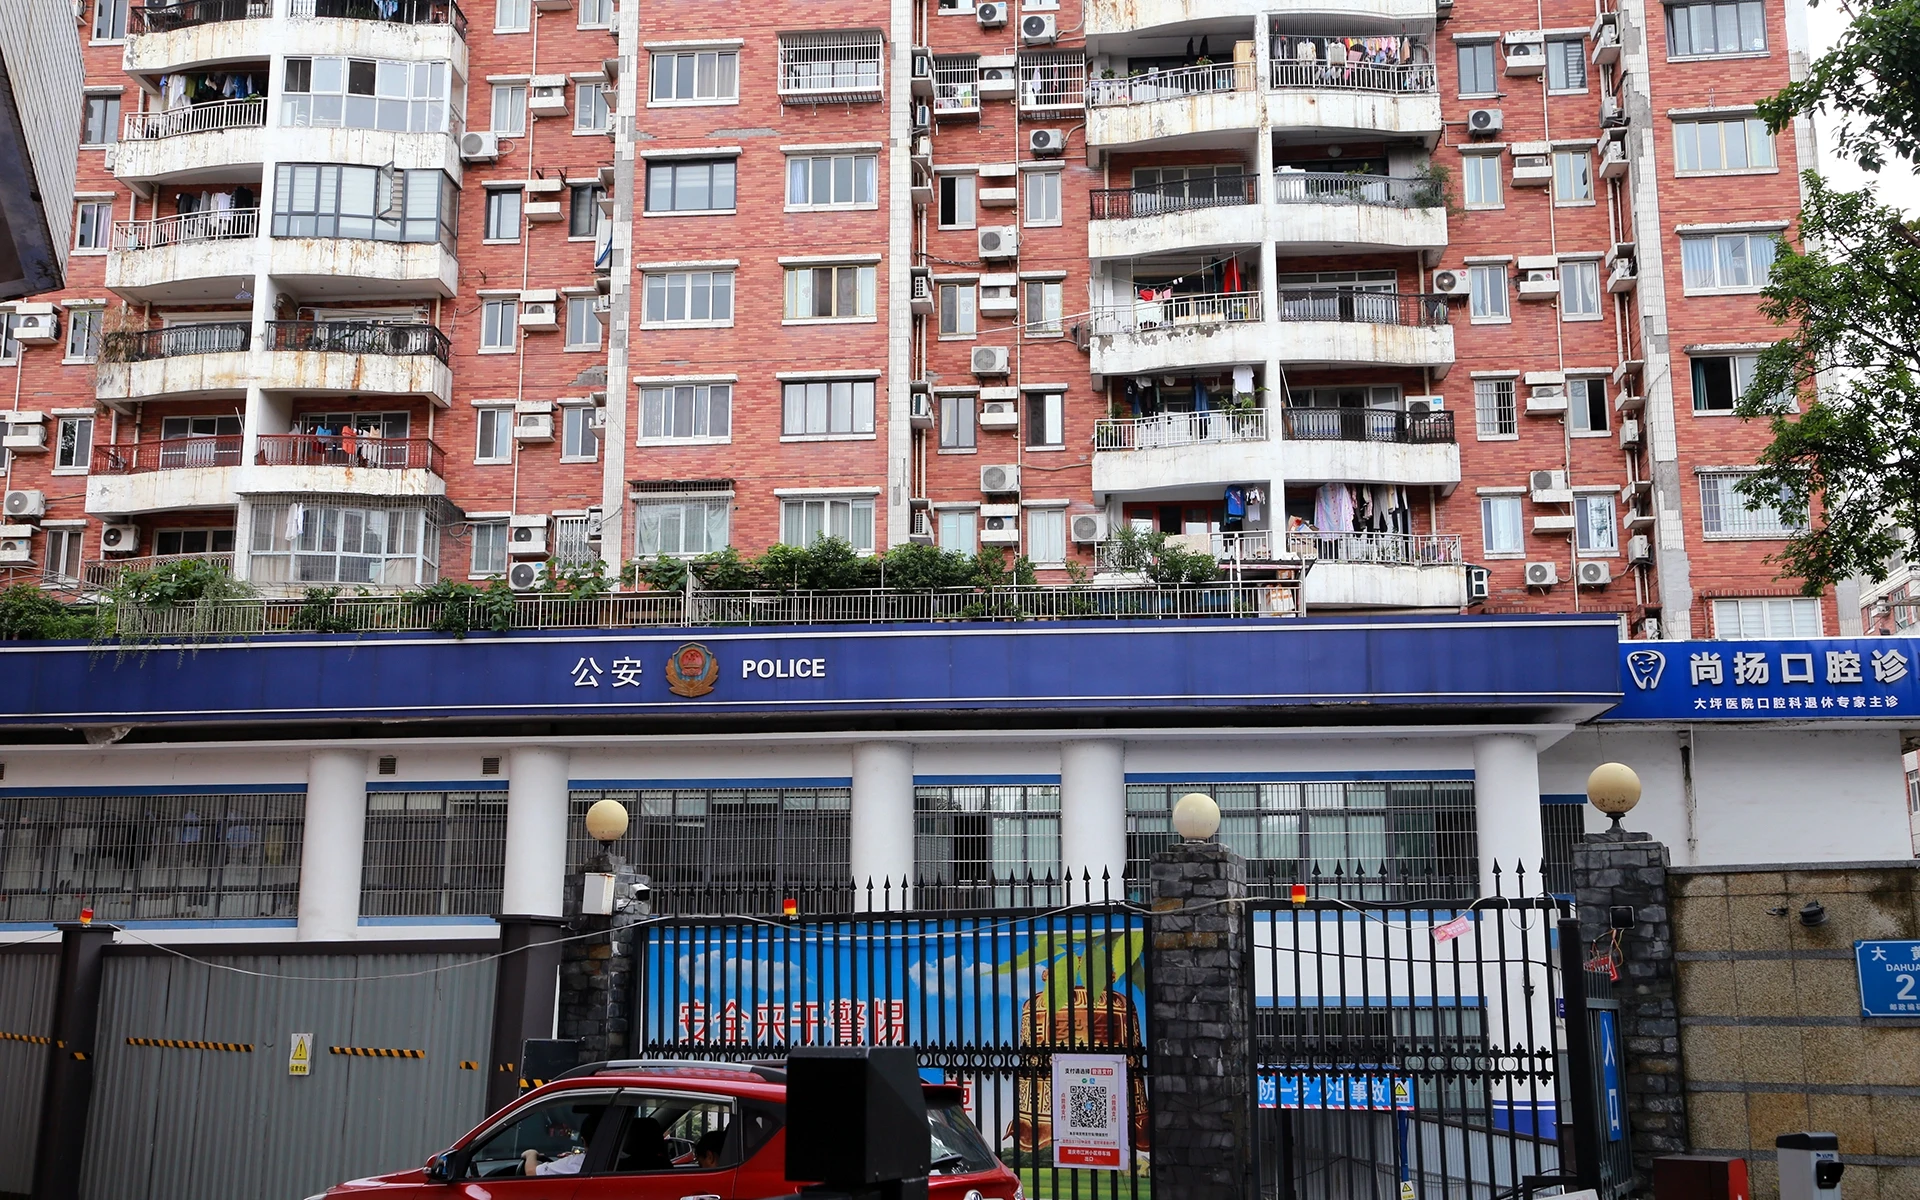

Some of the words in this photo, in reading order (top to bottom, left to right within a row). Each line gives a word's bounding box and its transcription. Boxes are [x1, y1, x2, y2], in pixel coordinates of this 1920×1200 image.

[571, 656, 643, 688] 公安
[742, 659, 826, 679] POLICE
[1690, 649, 1909, 686] 尚扬口腔诊
[1694, 696, 1899, 710] 大坪医院口腔科退休专家主诊
[1896, 974, 1917, 1000] 2
